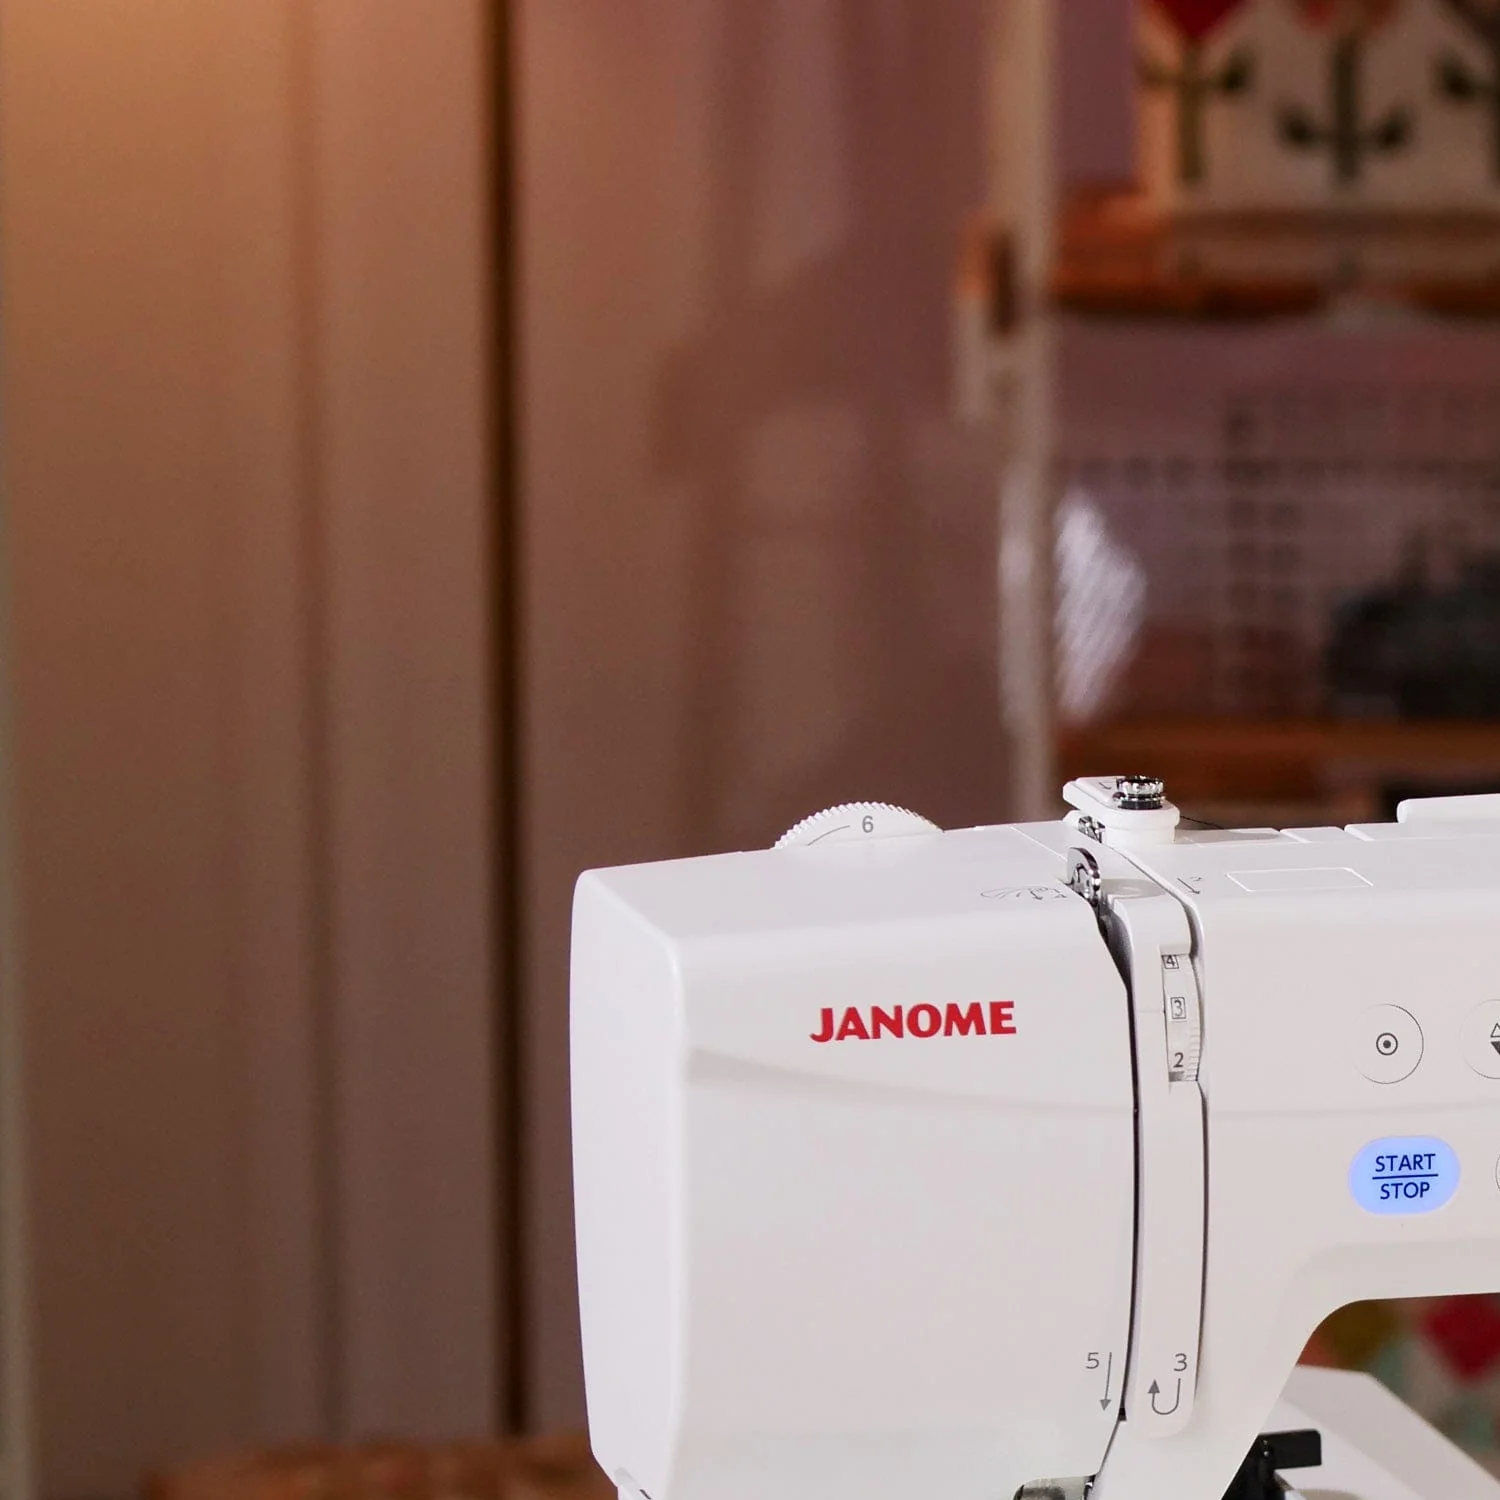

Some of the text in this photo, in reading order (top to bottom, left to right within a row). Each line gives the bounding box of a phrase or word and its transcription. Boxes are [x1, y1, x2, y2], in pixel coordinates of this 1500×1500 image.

[861, 815, 875, 834] 6
[1173, 999, 1184, 1017] 3
[809, 1000, 1017, 1043] JANOME
[1173, 1052, 1184, 1068] 2
[1374, 1152, 1437, 1174] START
[1379, 1180, 1431, 1201] STOP
[1086, 1352, 1100, 1369] 5
[1173, 1354, 1188, 1371] 3
